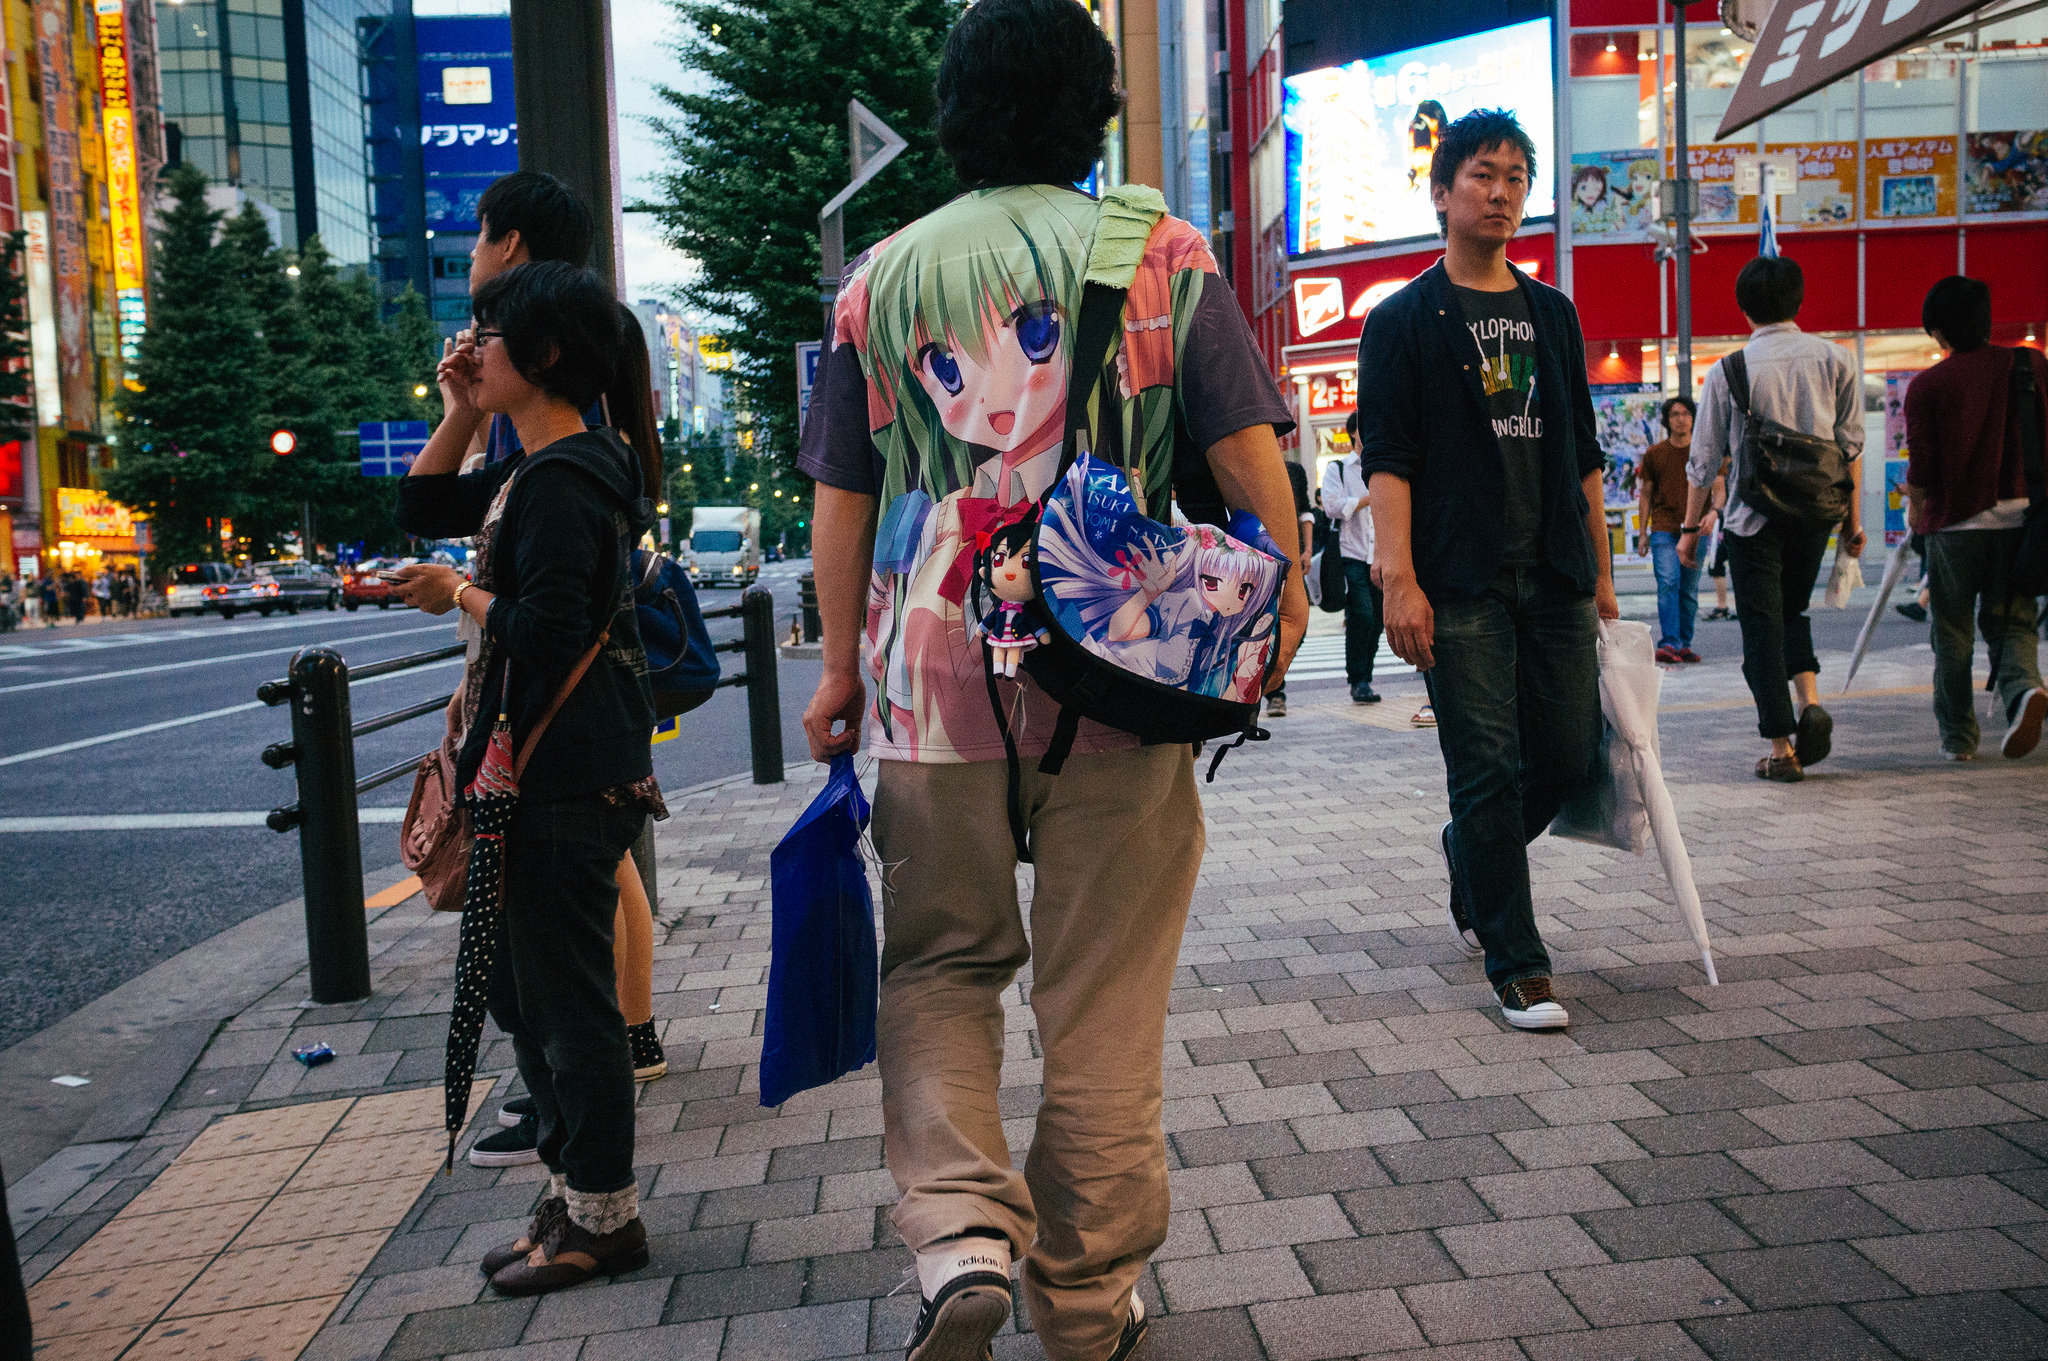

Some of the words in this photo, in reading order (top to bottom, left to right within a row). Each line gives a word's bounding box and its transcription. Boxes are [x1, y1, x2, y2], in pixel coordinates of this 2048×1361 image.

[1466, 318, 1537, 342] YLOPHON
[1312, 376, 1339, 409] 2F
[957, 1254, 1003, 1270] adidas
